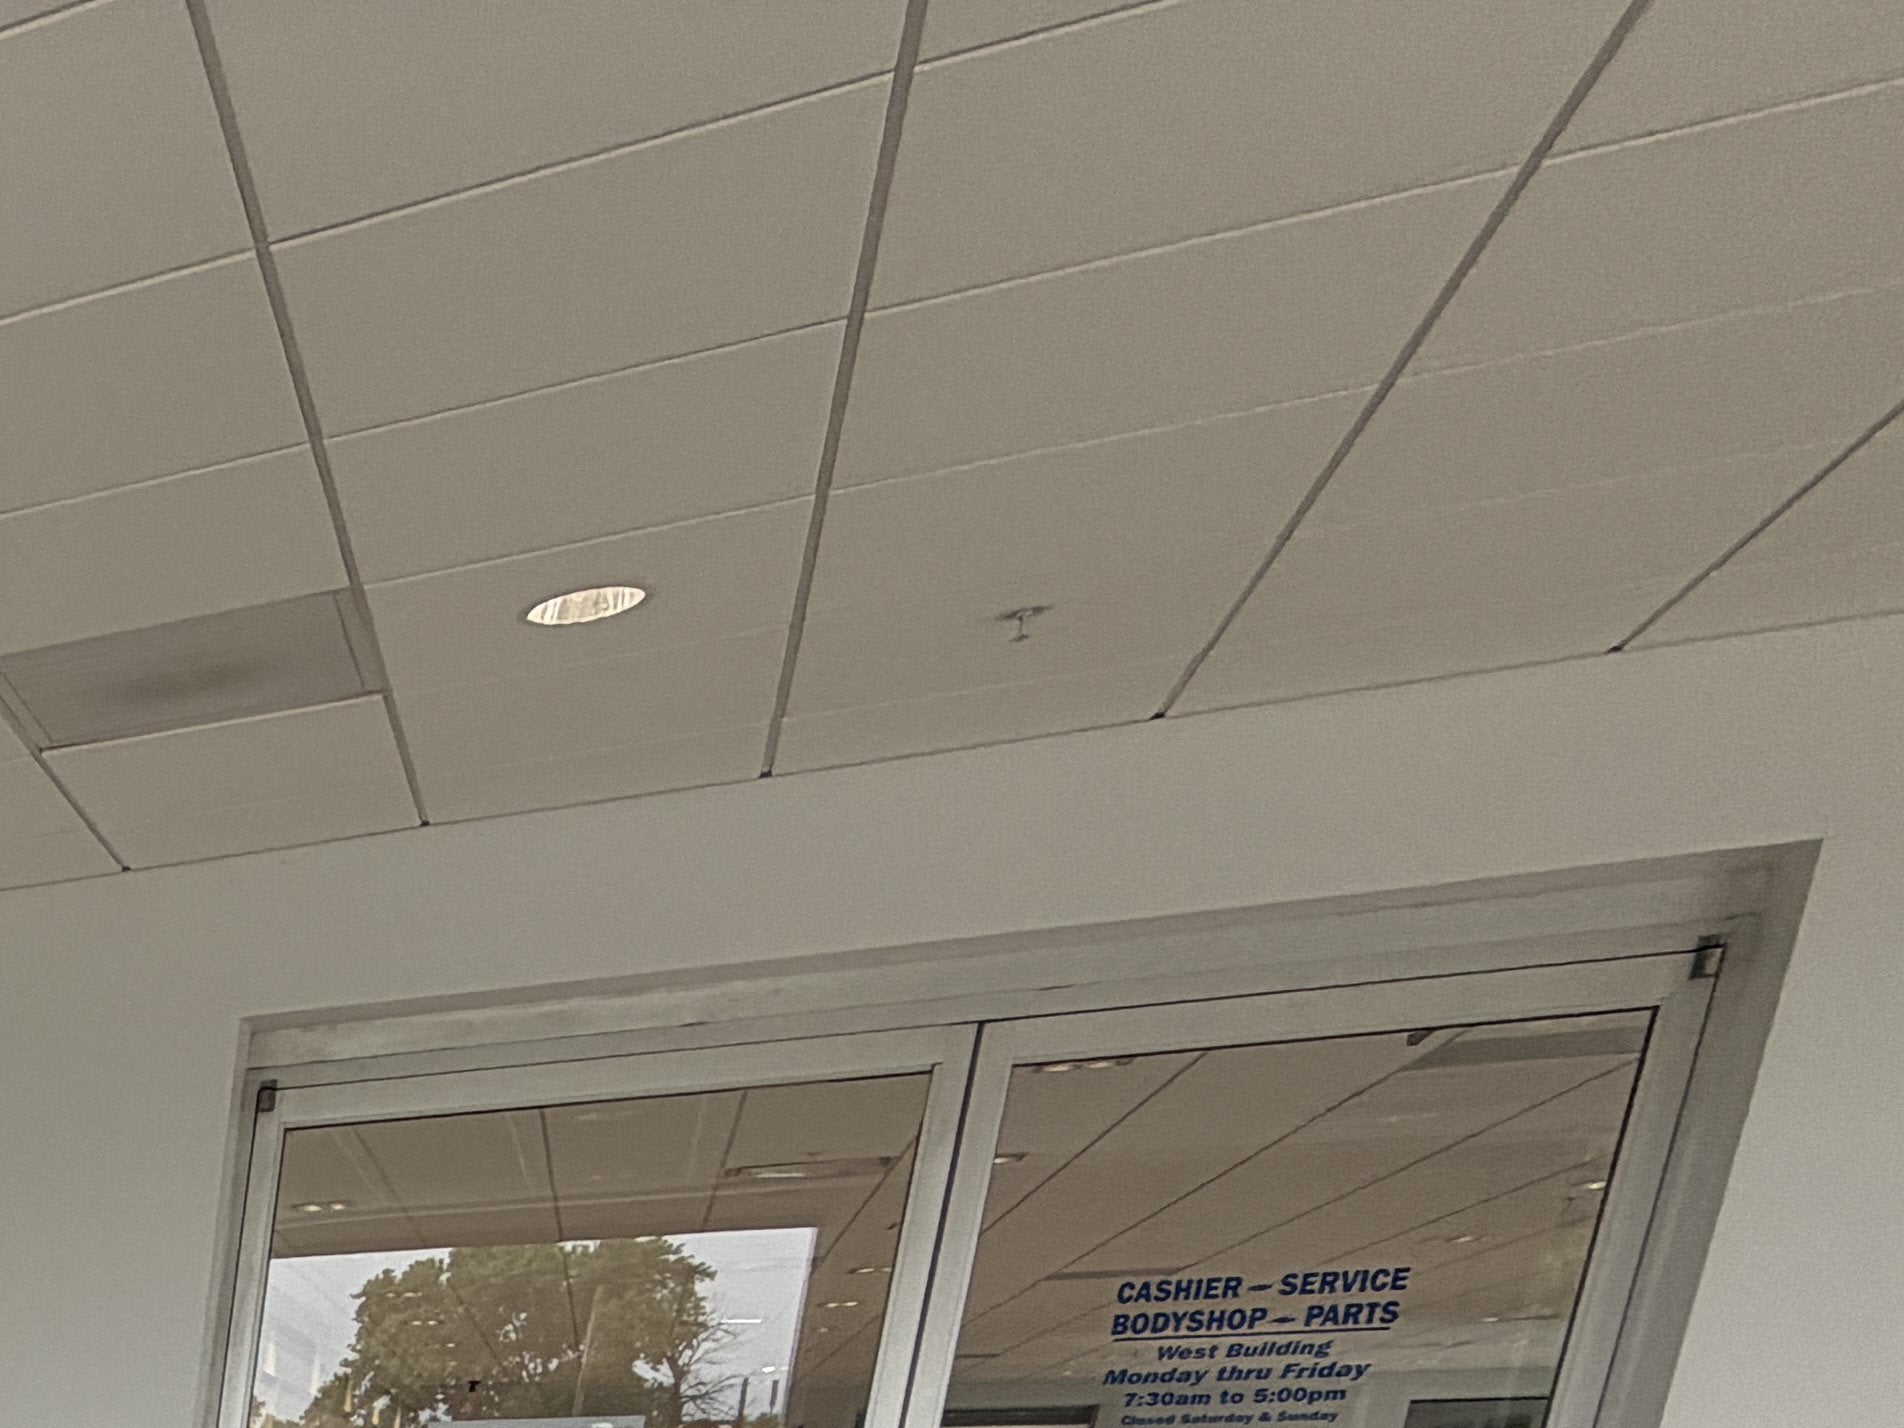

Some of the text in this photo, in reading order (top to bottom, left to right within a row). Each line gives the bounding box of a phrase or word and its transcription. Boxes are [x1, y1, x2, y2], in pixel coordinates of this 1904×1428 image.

[1117, 1267, 1411, 1304] CASHIER SERVICE
[1111, 1301, 1400, 1335] BODYSHOP PARTS
[1157, 1339, 1335, 1361] West Building
[1102, 1362, 1371, 1386] Monday thru Friday
[1124, 1387, 1347, 1407] 7:30am to 5:00pm
[1121, 1414, 1176, 1425] Closed
[1181, 1413, 1253, 1425] Saturday
[1277, 1410, 1338, 1423] Sunday
